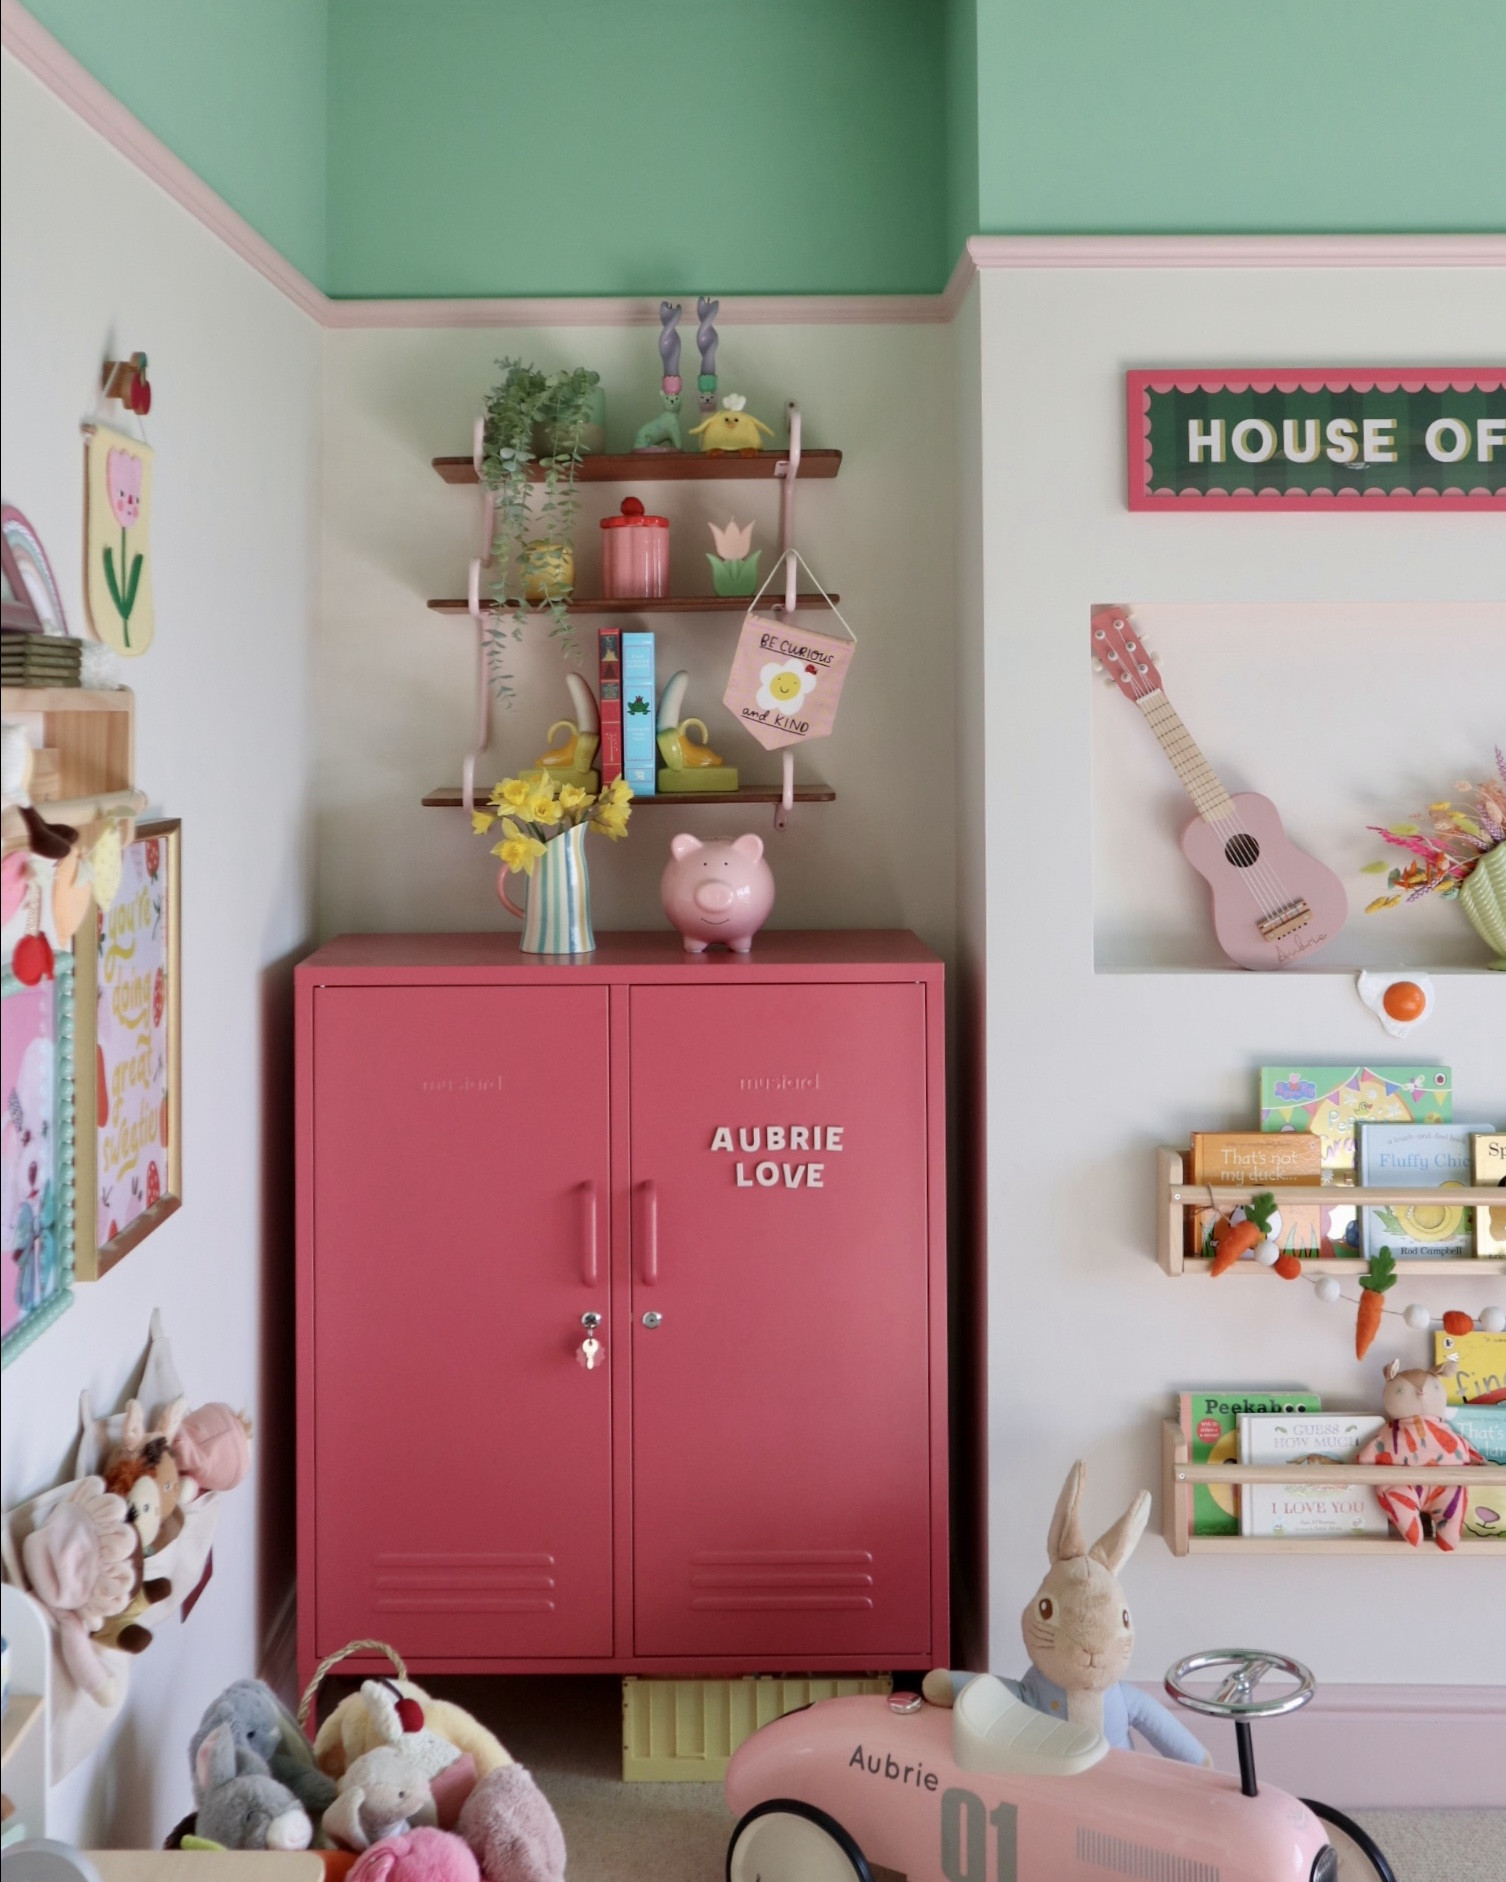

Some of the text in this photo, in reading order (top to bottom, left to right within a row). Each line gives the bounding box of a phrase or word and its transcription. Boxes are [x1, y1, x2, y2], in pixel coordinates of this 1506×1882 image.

[1188, 418, 1506, 463] HOUSE OF
[760, 633, 835, 664] BE CURIOUS
[742, 706, 809, 733] and KIND
[112, 966, 151, 1029] doing
[112, 1034, 152, 1127] great
[710, 1125, 844, 1153] AUBRIE
[1221, 1148, 1298, 1165] That's not
[1379, 1153, 1471, 1171] Fluffy Chic
[735, 1161, 825, 1189] LOVE
[1221, 1170, 1245, 1187] my
[1401, 1247, 1462, 1257] Rod Campbell
[1456, 1370, 1506, 1404] fin
[1274, 1436, 1359, 1448] HOW MUCH
[1293, 1424, 1340, 1435] GUESS
[1457, 1421, 1504, 1440] That's
[1271, 1501, 1365, 1514] I LOVE YOU
[849, 1744, 939, 1792] Aubrie
[941, 1787, 1018, 1882] 01
